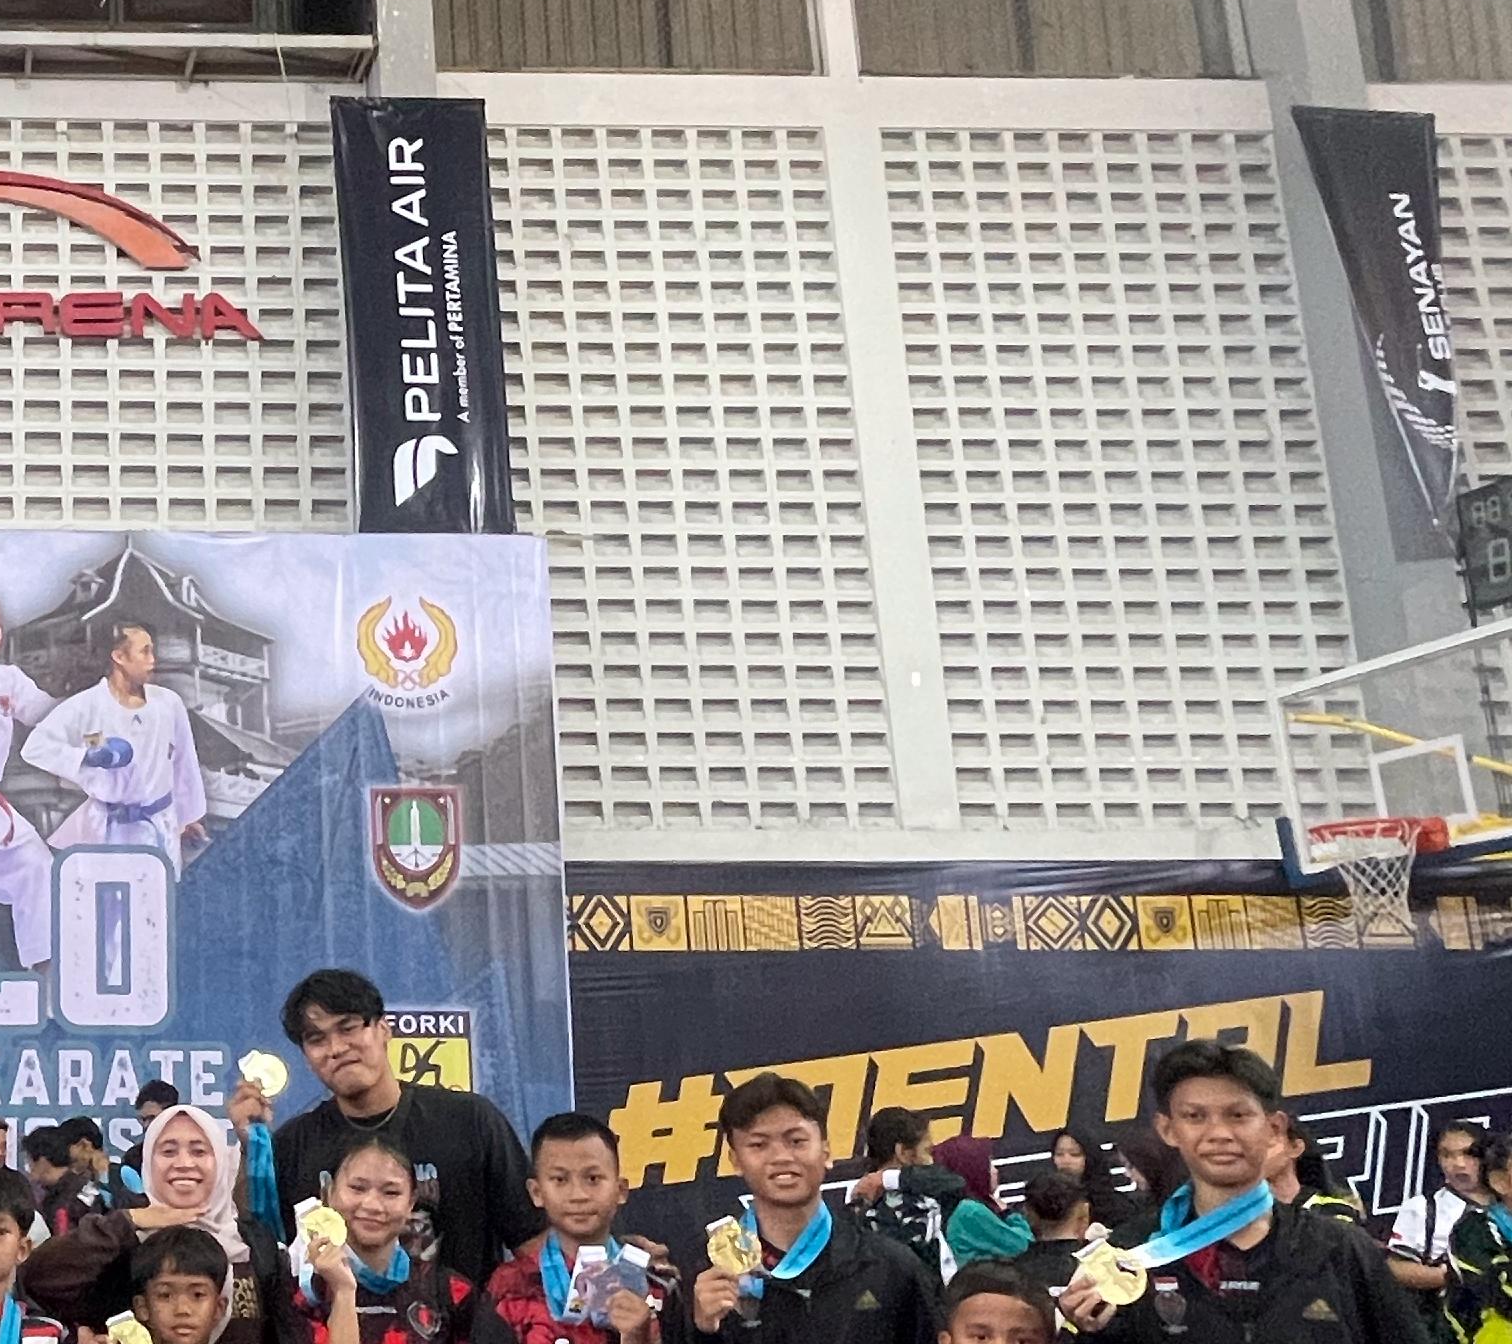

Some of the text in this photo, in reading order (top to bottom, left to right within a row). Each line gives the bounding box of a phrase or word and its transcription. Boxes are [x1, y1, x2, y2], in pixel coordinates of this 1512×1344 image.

[388, 136, 442, 422] PELITA AIR
[440, 230, 464, 333] PERTAMINA
[1388, 192, 1452, 360] SENAYAN
[456, 411, 471, 424] A
[368, 688, 450, 709] INDONESIA
[385, 1014, 464, 1034] FORKI
